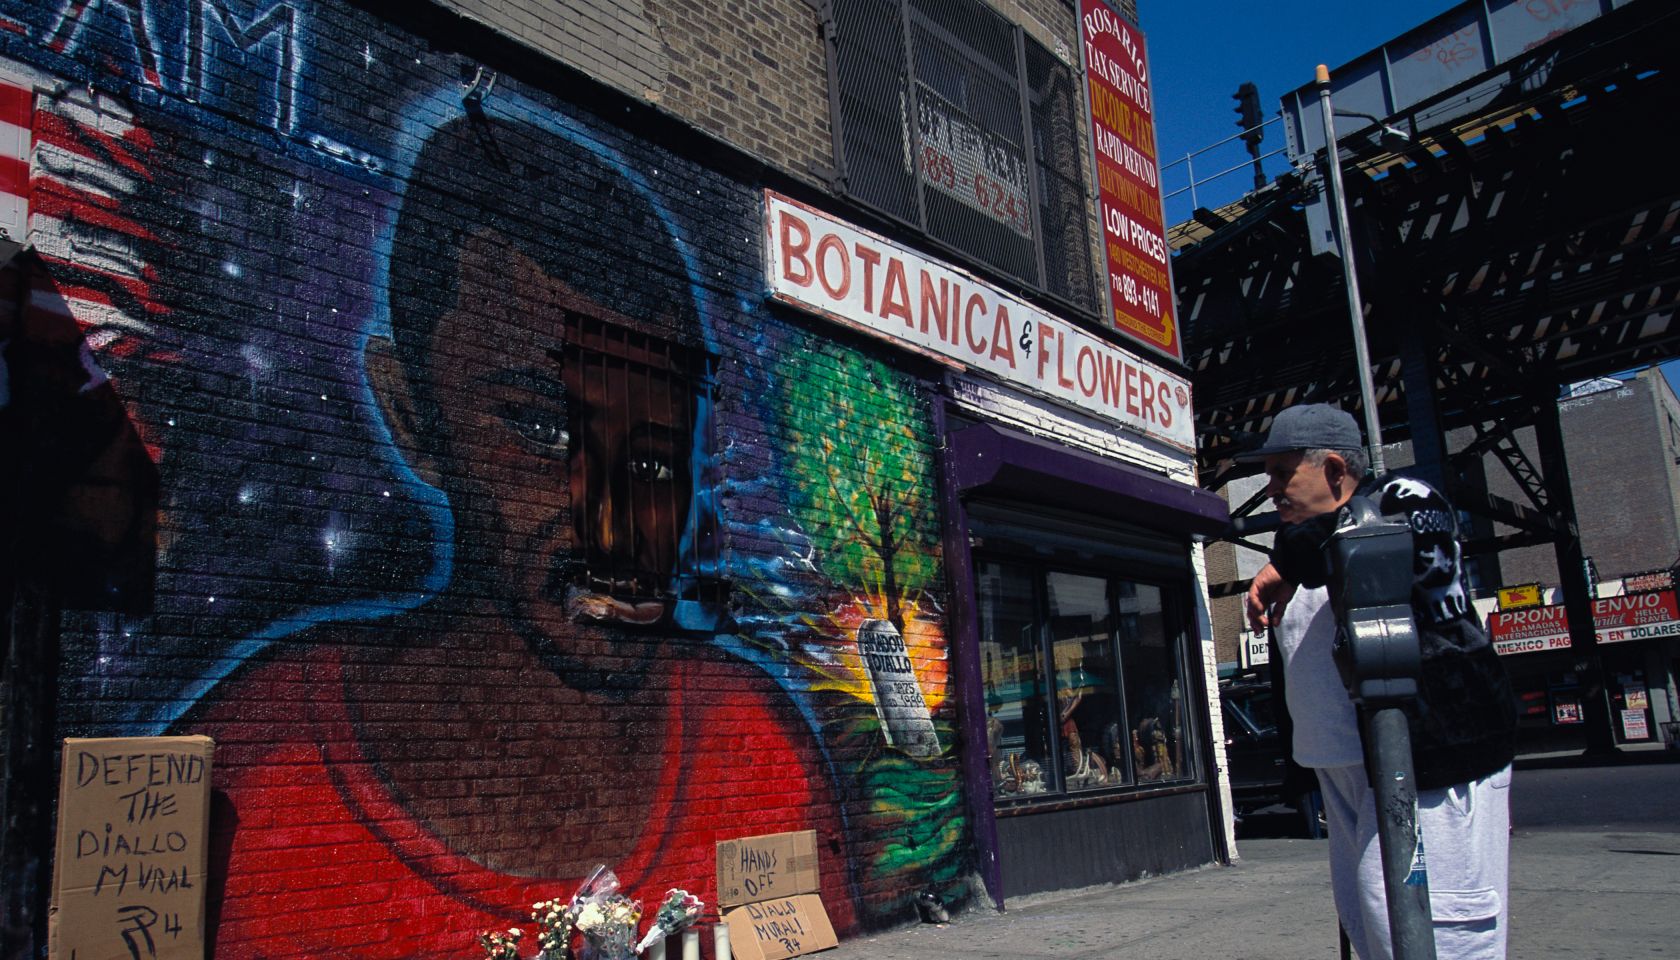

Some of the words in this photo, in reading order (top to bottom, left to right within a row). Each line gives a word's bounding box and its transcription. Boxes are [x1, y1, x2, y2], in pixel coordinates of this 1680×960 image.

[1083, 7, 1146, 83] ROSARIO
[1085, 40, 1109, 81] TAX
[1109, 59, 1150, 113] SERVICE
[1089, 78, 1132, 141] INCOME
[1133, 111, 1155, 159] TAX
[1095, 122, 1123, 164] RAPID
[1123, 142, 1156, 188] REFUND
[1098, 159, 1140, 212] ELECTRONIC
[1140, 188, 1162, 226] FILING
[1104, 203, 1128, 242] LOW
[1130, 219, 1166, 264] PRICES
[1111, 273, 1122, 293] 718
[1121, 248, 1157, 284] WESTCHESTER
[778, 209, 1016, 370] BOTANICA
[1019, 321, 1033, 360] &
[1037, 321, 1172, 428] FLOWERS
[1499, 604, 1566, 627] PRONT
[1595, 593, 1660, 614] ENVIO
[1510, 620, 1561, 633] LLAMADAS
[1633, 613, 1673, 624] TRAVEL
[1634, 606, 1668, 617] HELLO
[1495, 626, 1569, 642] INTERNACIONAL
[1497, 639, 1544, 655] MEXICO
[1549, 635, 1571, 649] PAG
[1608, 630, 1625, 641] EN
[871, 654, 912, 674] DIALLO
[894, 682, 915, 695] 1975
[75, 751, 206, 790] DEFEND
[119, 787, 178, 824] THE
[740, 845, 777, 873] HANDS
[94, 861, 194, 897] MURAL
[744, 871, 777, 897] OFF
[754, 917, 805, 940] MURAL!
